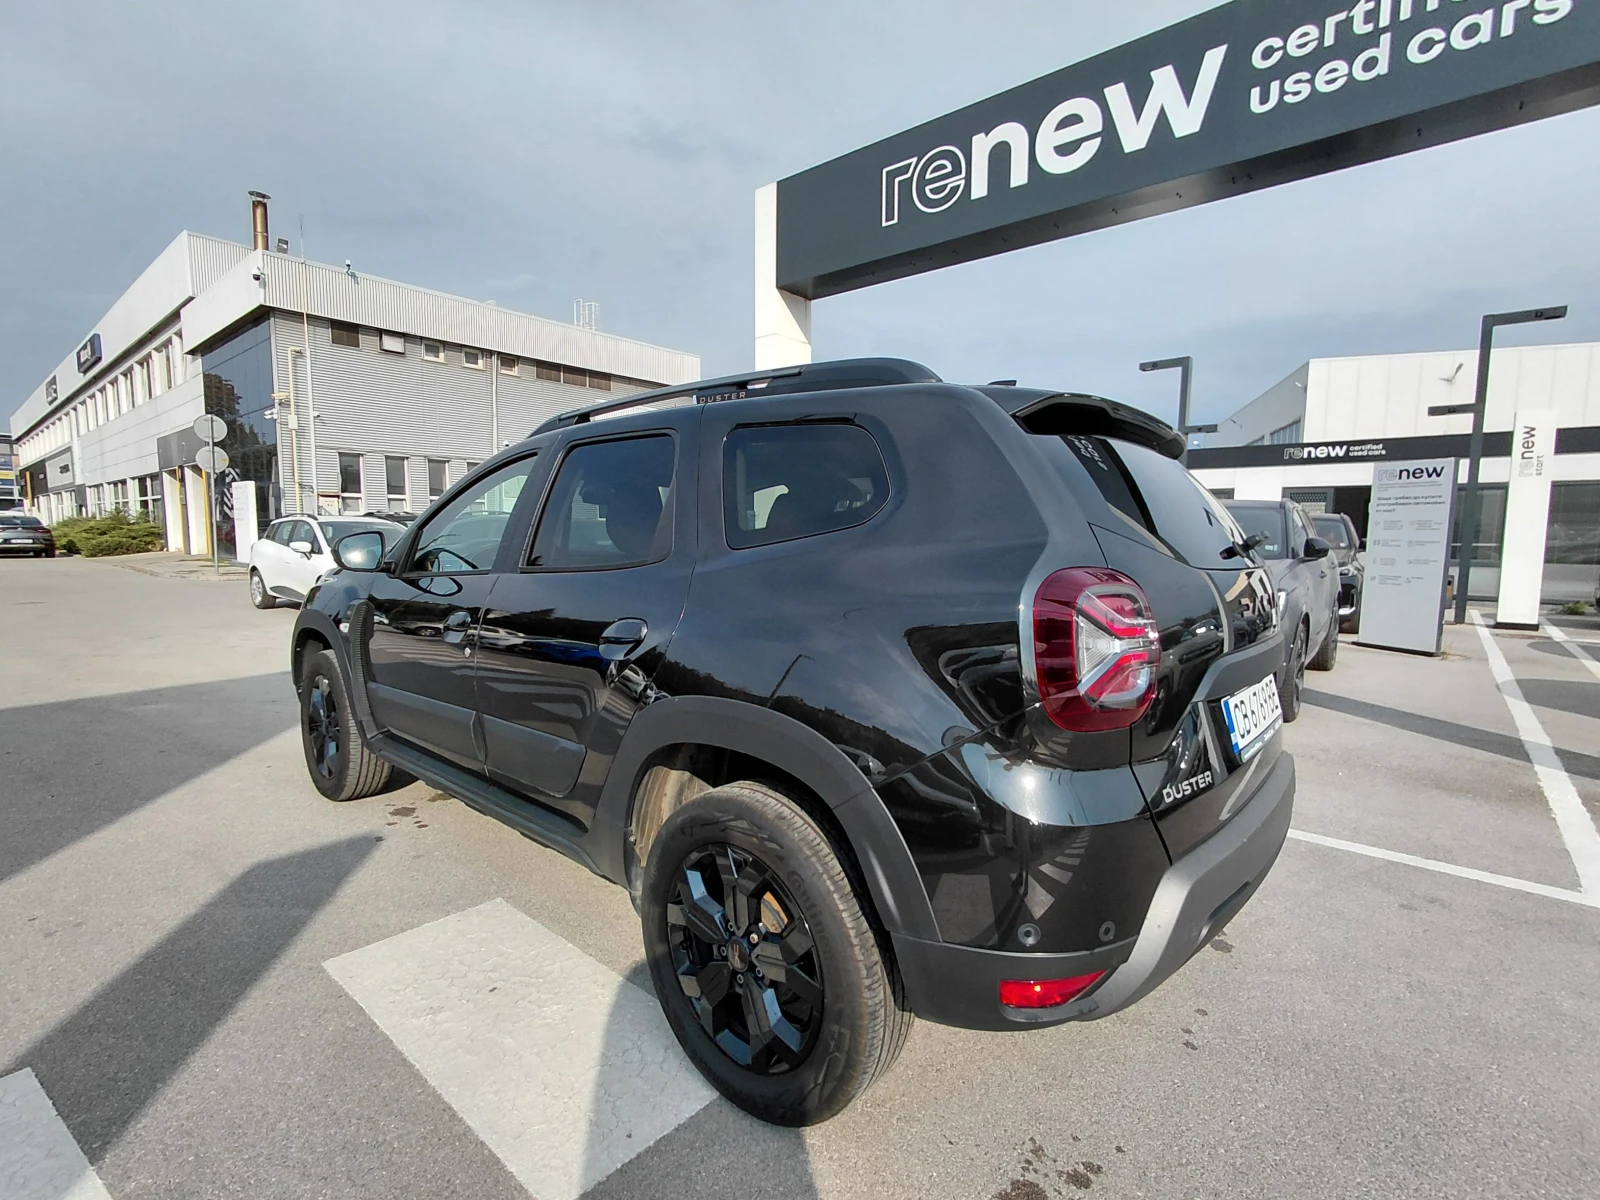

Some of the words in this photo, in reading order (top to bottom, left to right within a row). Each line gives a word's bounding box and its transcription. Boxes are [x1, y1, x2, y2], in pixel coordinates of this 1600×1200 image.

[1249, 32, 1391, 114] used
[1406, 0, 1574, 64] cars
[880, 43, 1228, 228] renew
[699, 391, 746, 404] DUSTER
[1283, 445, 1348, 460] renew
[1349, 443, 1383, 451] certified
[1349, 449, 1367, 457] used
[1518, 426, 1537, 477] renew
[1378, 465, 1445, 482] renew
[1535, 454, 1544, 477] start
[1162, 770, 1213, 804] DUSTER
